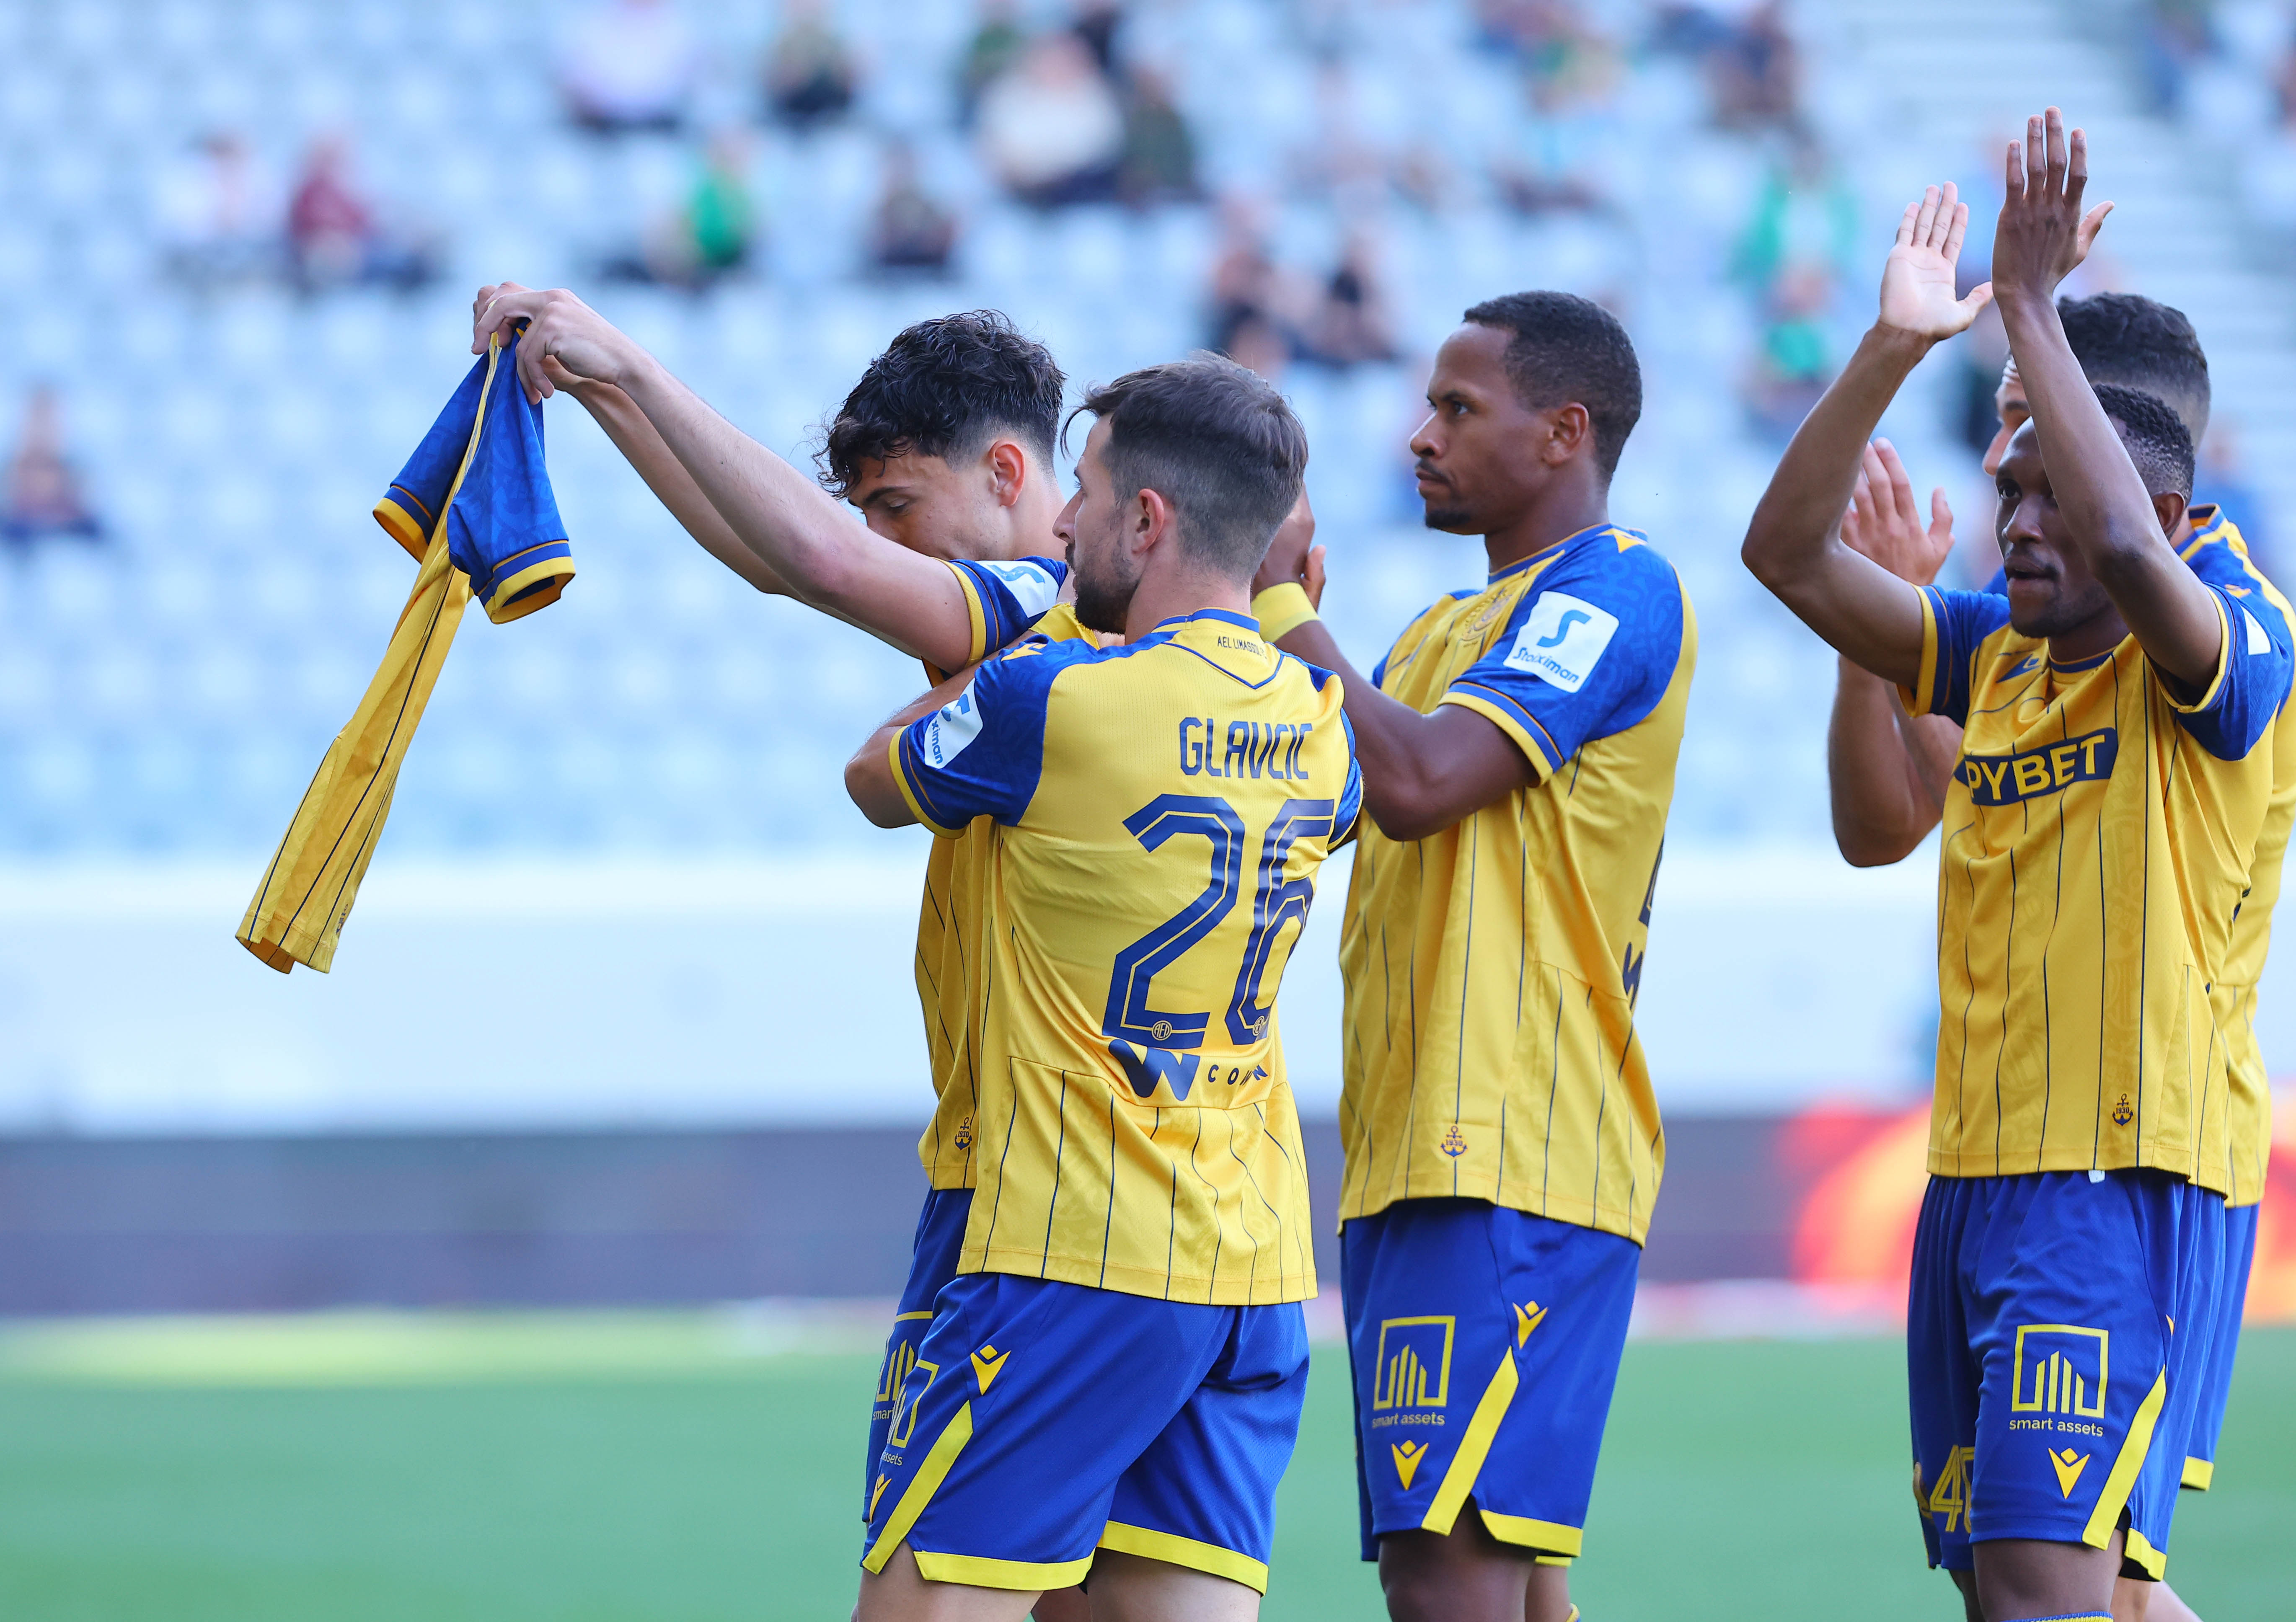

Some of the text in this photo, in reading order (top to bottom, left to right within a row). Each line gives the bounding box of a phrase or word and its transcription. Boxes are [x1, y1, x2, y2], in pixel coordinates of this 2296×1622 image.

[1217, 635, 1232, 648] AEL
[1179, 717, 1312, 780] GLAVCIC
[1102, 793, 1335, 1050] 26
[1372, 1412, 1445, 1429] smart assets
[2009, 1418, 2104, 1437] smart assets
